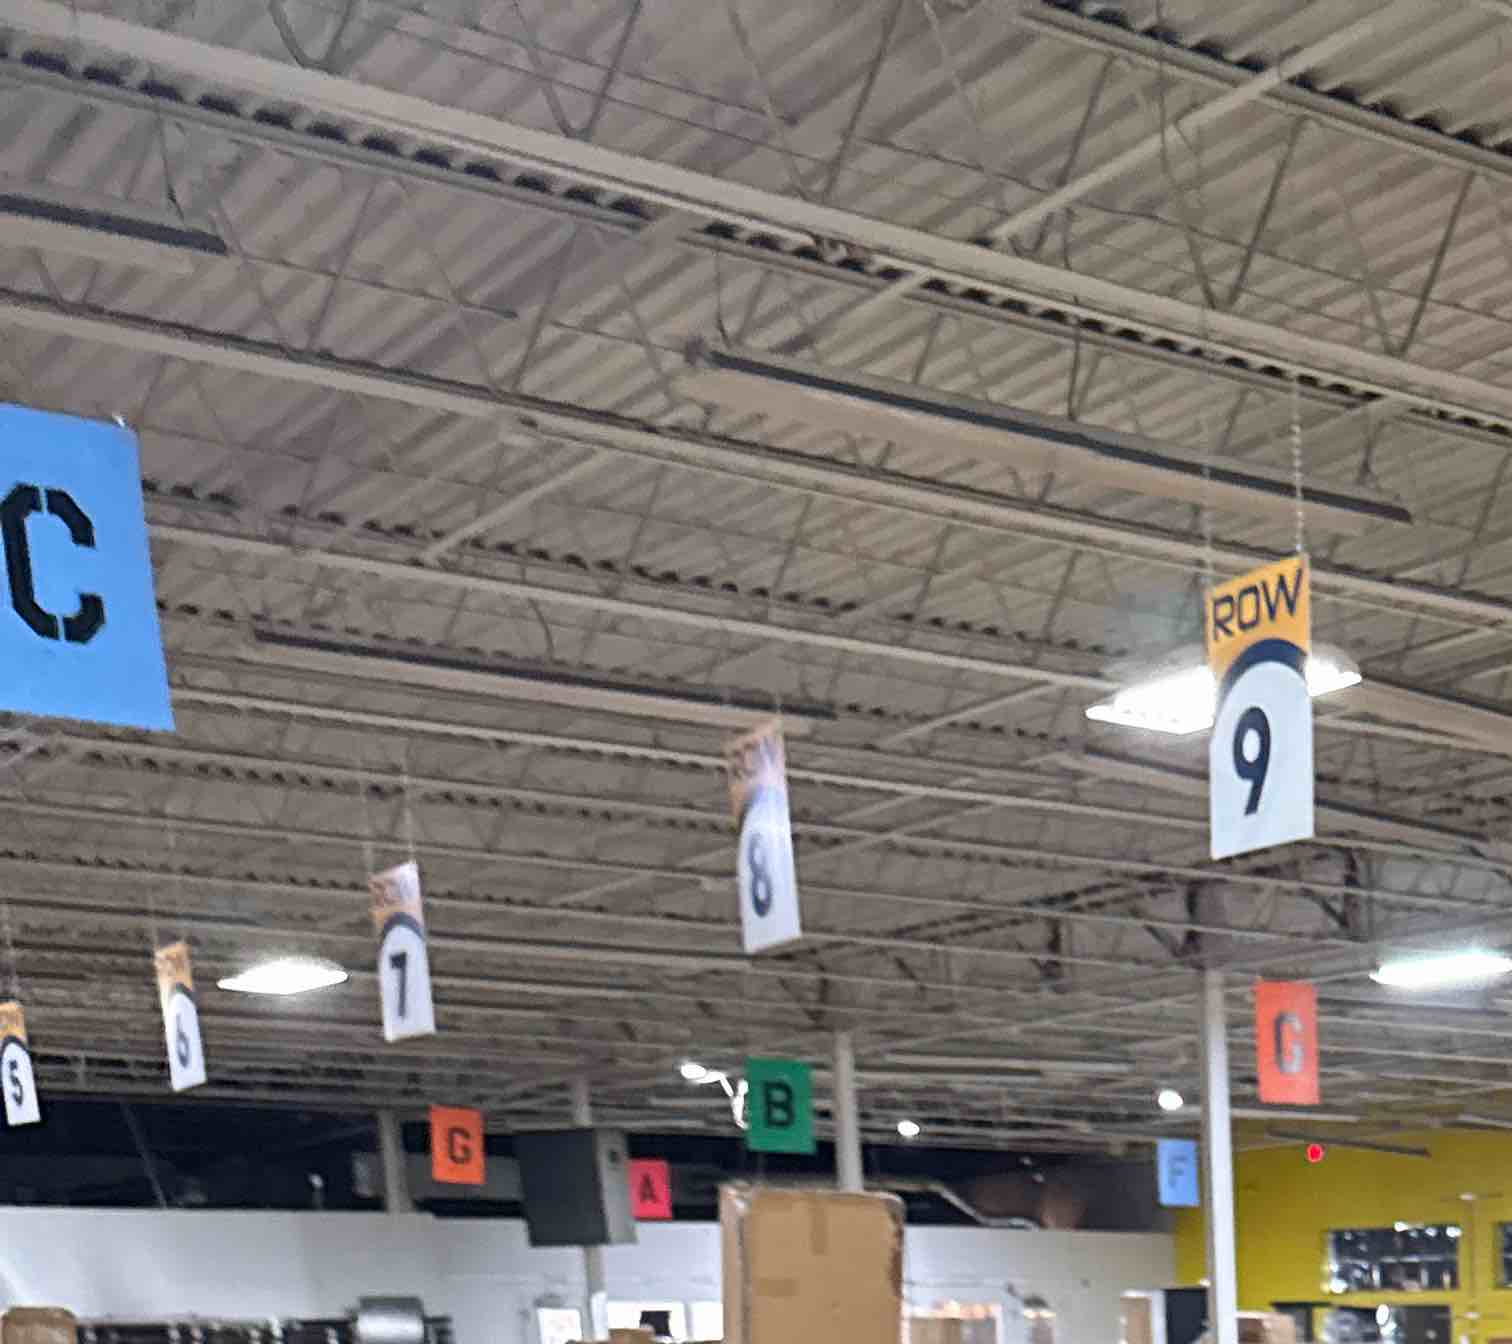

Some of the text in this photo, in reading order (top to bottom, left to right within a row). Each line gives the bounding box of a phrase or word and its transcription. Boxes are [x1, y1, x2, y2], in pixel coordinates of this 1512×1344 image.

[0, 482, 106, 644] C
[1213, 567, 1303, 640] ROW
[1232, 705, 1271, 816] 9
[749, 832, 772, 917] 8
[389, 952, 407, 1019] 7
[175, 1012, 189, 1068] 6
[9, 1060, 23, 1107] 5
[763, 1081, 796, 1128] B
[447, 1127, 472, 1165] G
[638, 1173, 658, 1205] A
